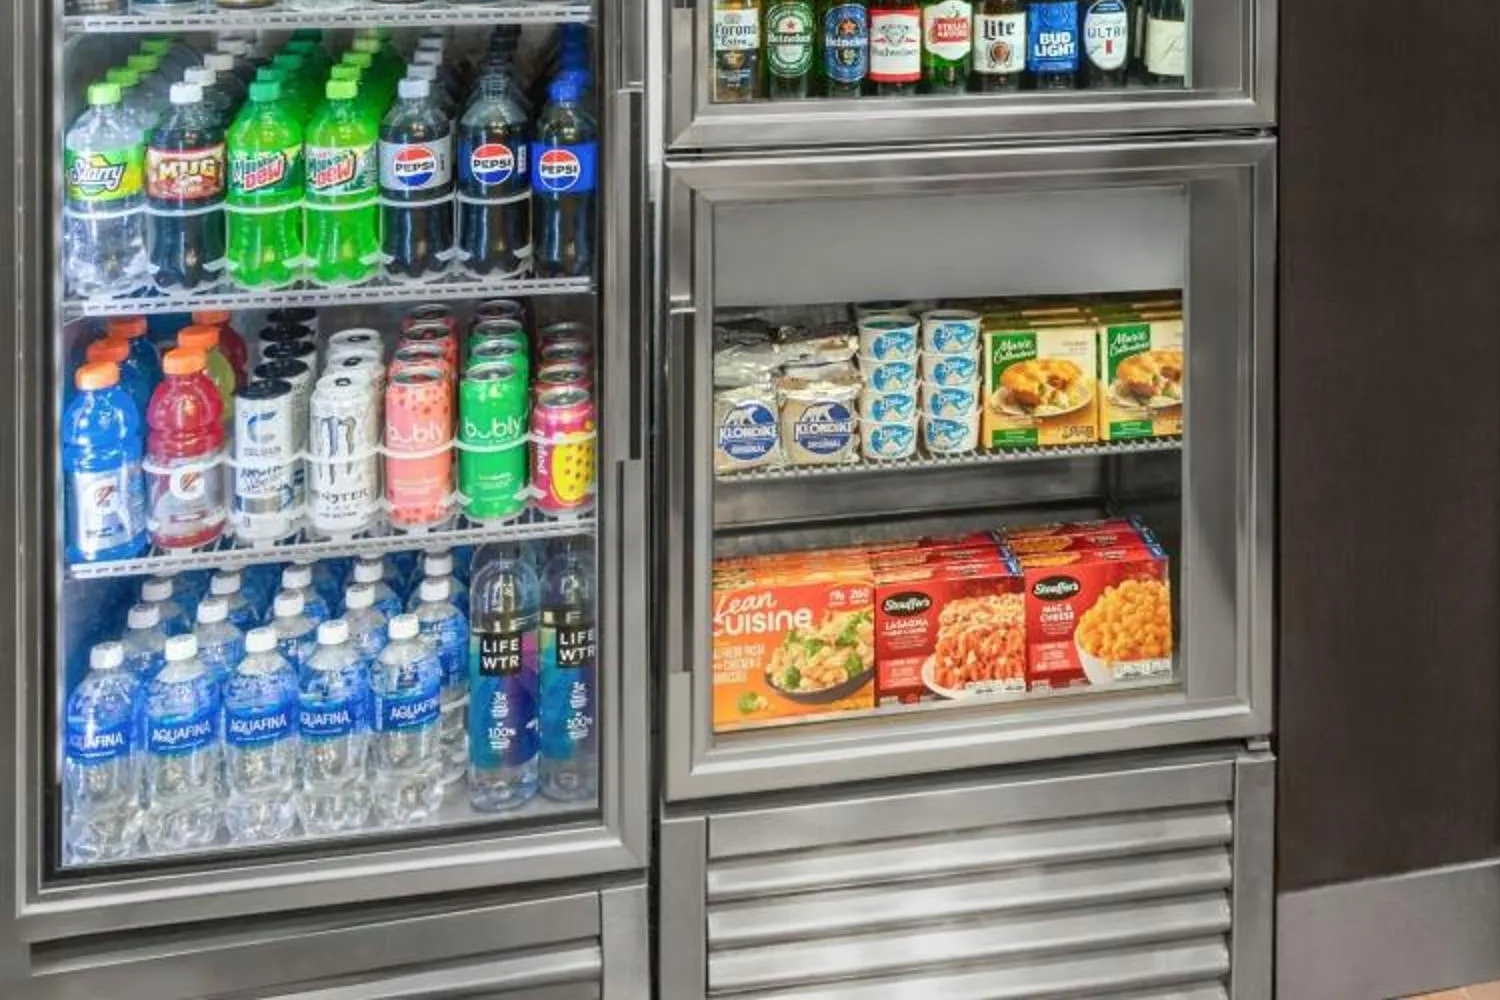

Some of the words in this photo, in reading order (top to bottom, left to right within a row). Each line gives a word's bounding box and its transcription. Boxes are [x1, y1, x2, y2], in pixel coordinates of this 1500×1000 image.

[983, 18, 1016, 41] Lite
[1039, 31, 1071, 45] BUD
[1034, 42, 1075, 57] LIGHT
[159, 159, 217, 178] MUG
[395, 162, 435, 173] PEPSI
[473, 158, 513, 168] PEPSI
[540, 163, 579, 174] PEPSI
[69, 159, 125, 190] Starry
[482, 638, 519, 652] LIFE
[559, 630, 595, 646] LIFE
[559, 645, 595, 662] WTR
[481, 655, 520, 670] WTR
[152, 719, 212, 744] AQUAFINA
[229, 713, 287, 735] AQUAFINA
